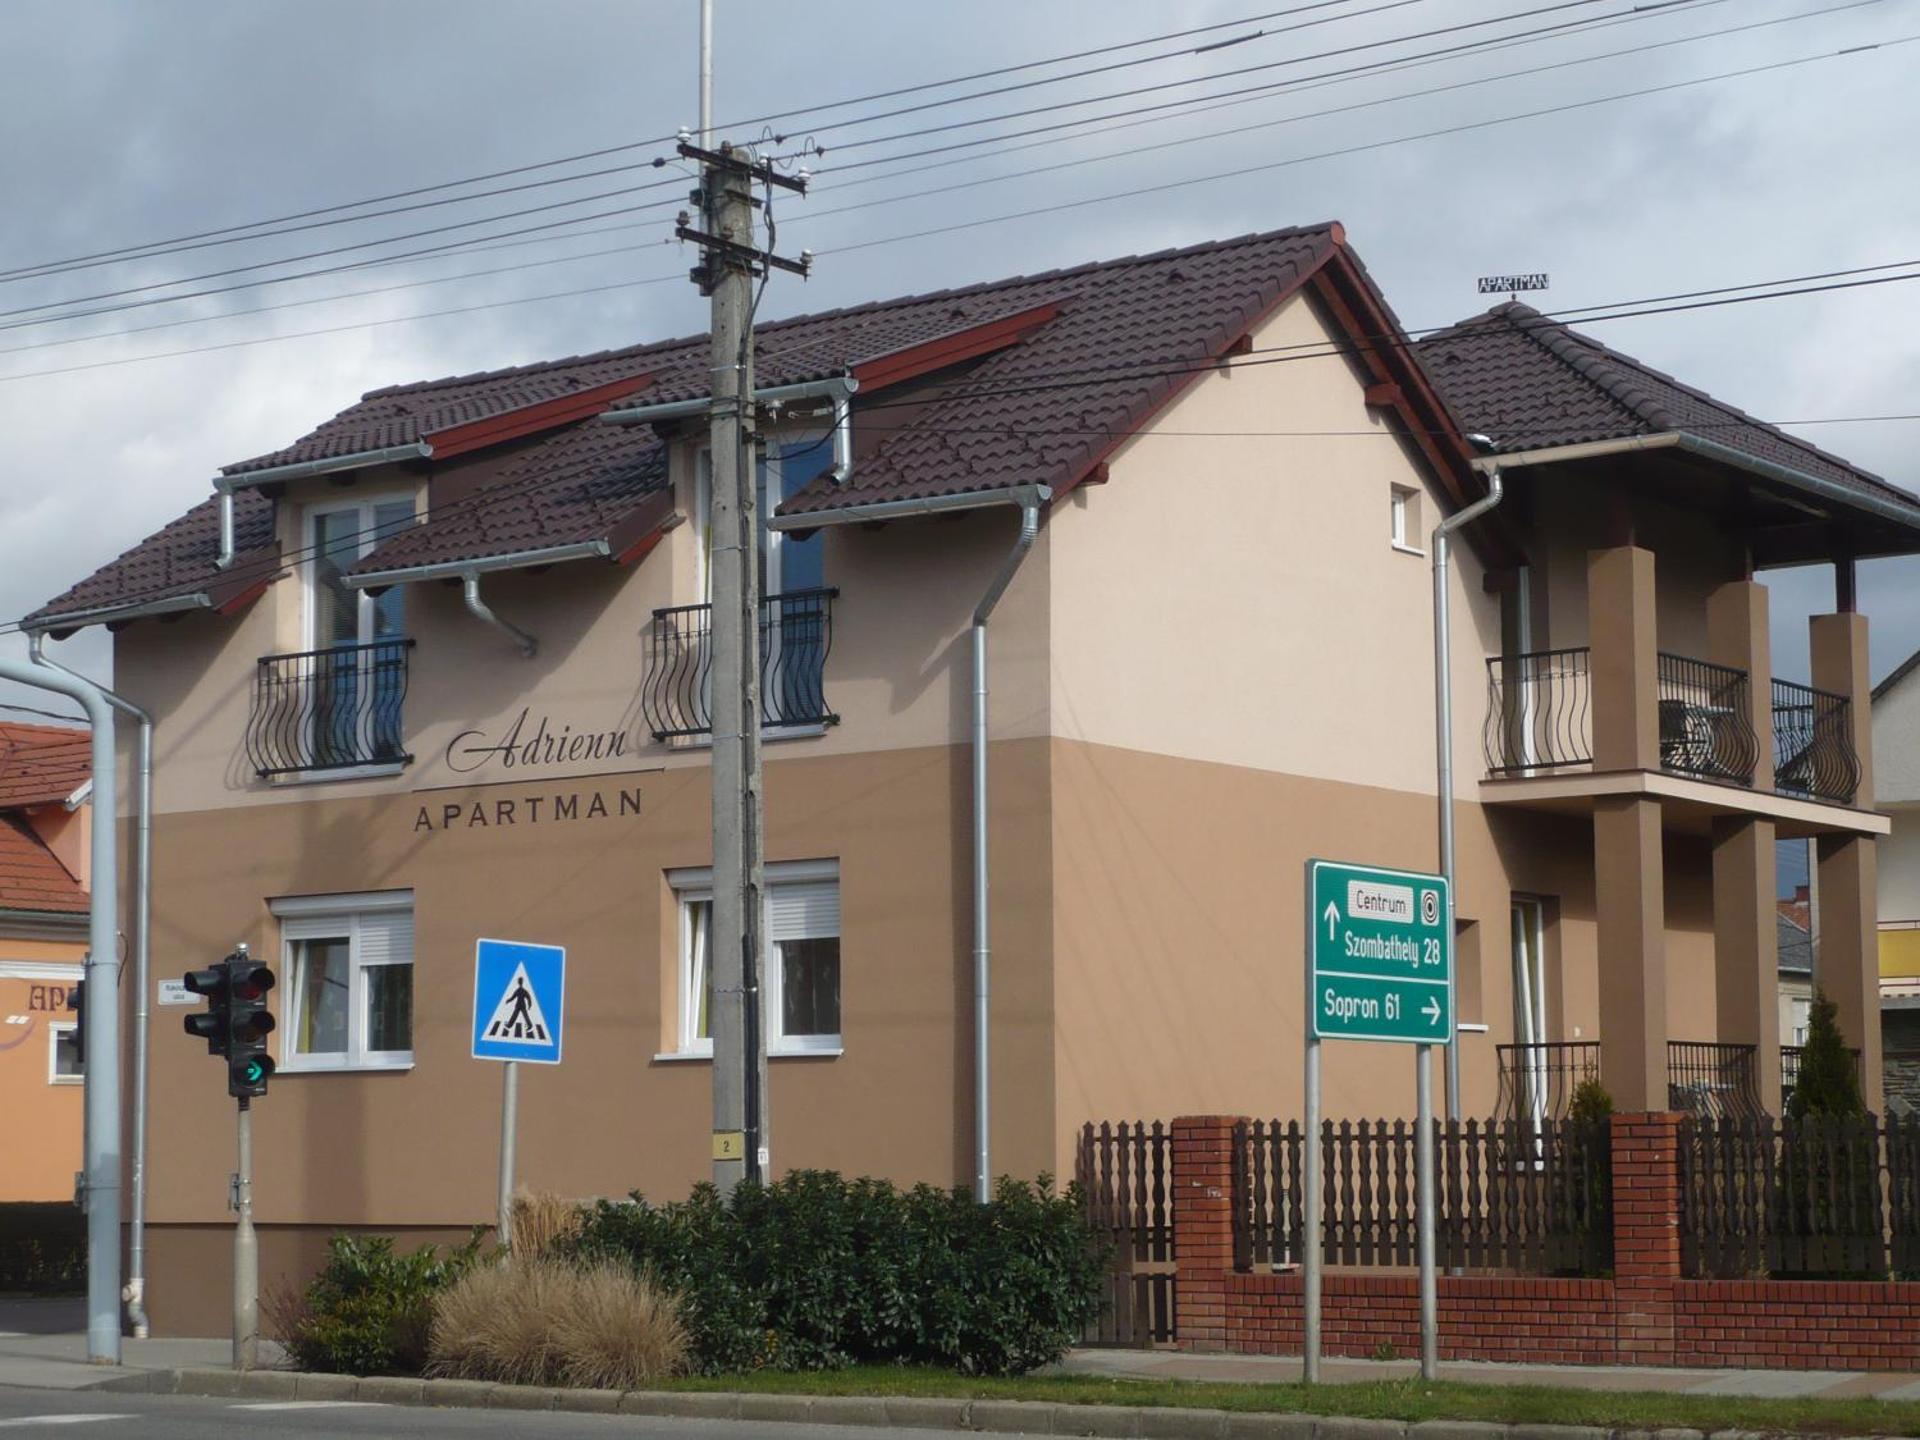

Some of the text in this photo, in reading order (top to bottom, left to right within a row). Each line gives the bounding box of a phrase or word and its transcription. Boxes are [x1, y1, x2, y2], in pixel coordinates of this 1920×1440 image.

[1479, 274, 1549, 292] APARTMAN
[446, 707, 627, 773] Adrienn
[414, 788, 642, 832] APARTMAN
[1356, 889, 1407, 915] Centrum
[1344, 930, 1441, 969] Szombathely 28
[29, 985, 78, 1011] AP
[1324, 988, 1401, 1024] Sopron 61
[723, 1140, 730, 1153] 2
